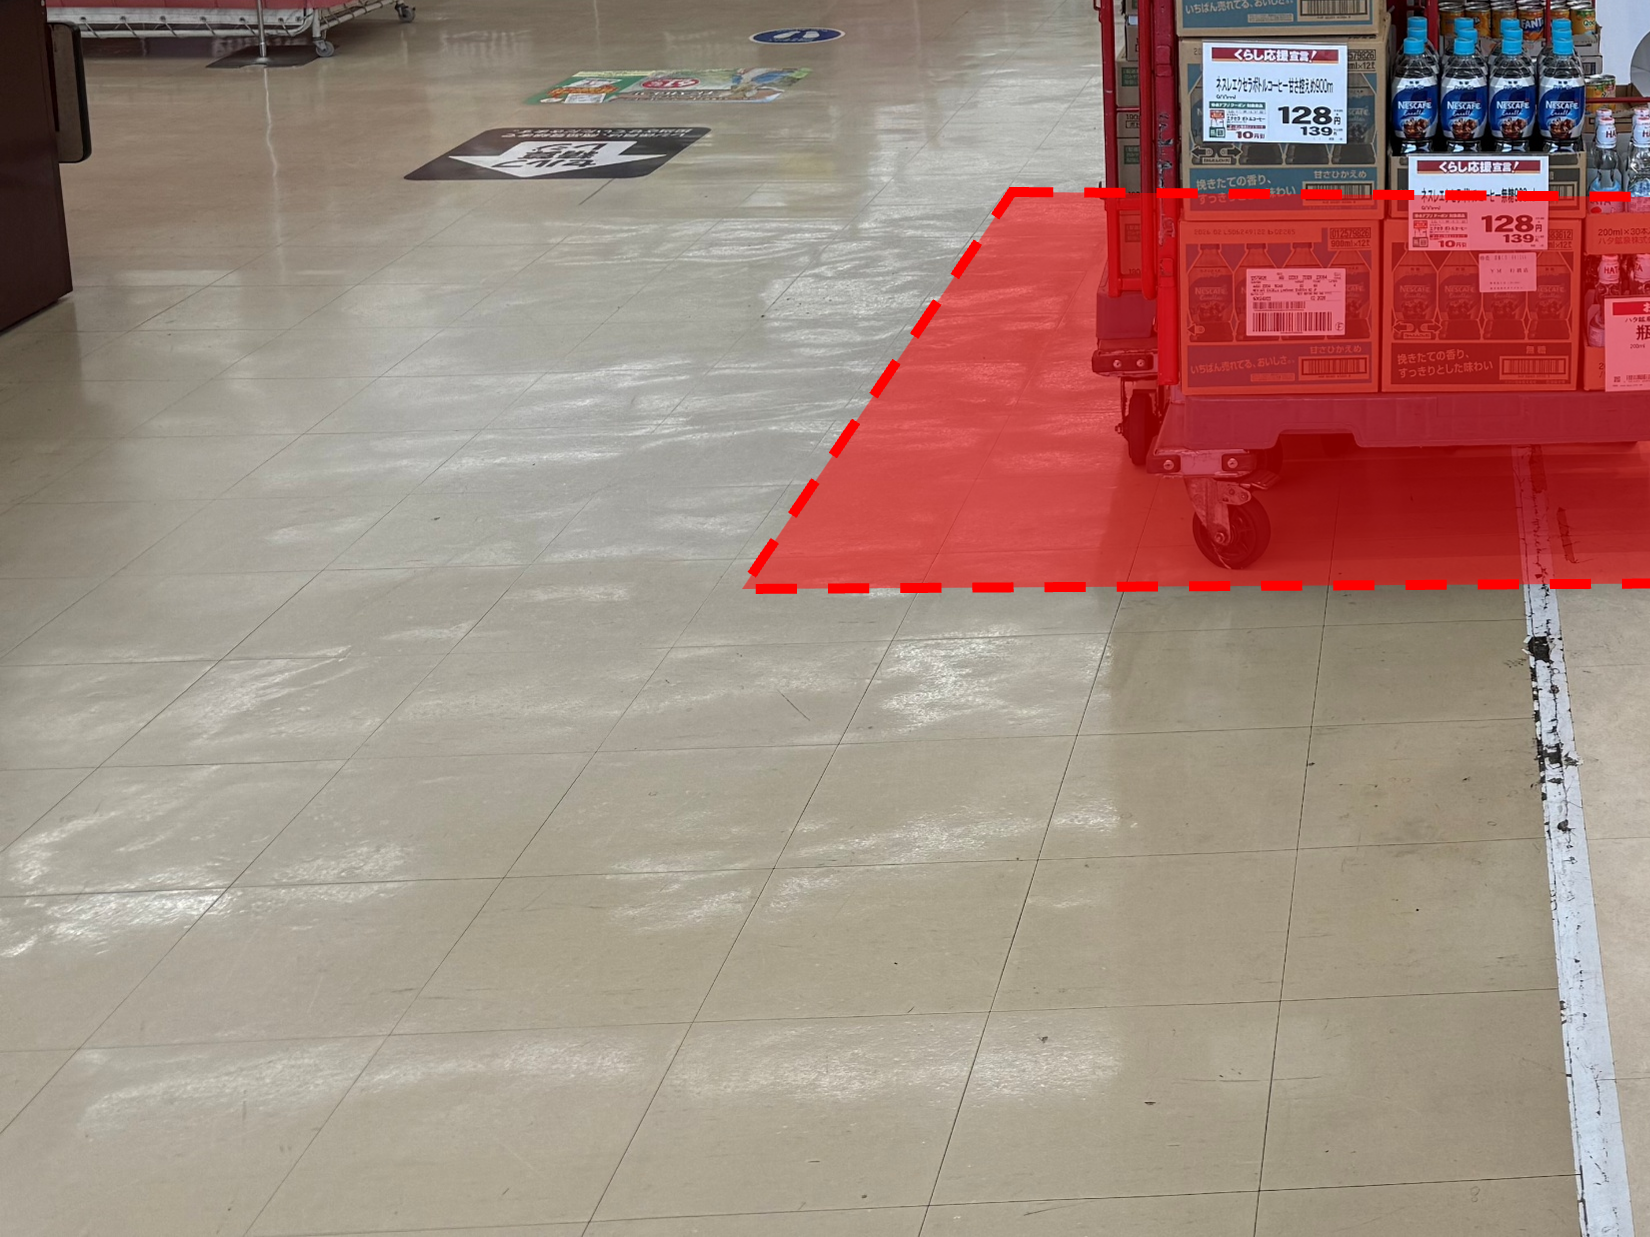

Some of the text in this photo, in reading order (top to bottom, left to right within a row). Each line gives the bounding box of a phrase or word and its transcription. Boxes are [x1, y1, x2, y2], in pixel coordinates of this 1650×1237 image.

[1234, 48, 1318, 63] くらし応援宣言!
[1277, 106, 1332, 125] 128
[1299, 126, 1333, 136] 139
[1438, 160, 1520, 174] くらし応援宣言!
[1313, 170, 1367, 179] 甘さひかえめ
[1481, 214, 1534, 233] 128
[1502, 233, 1534, 244] 139
[1309, 345, 1362, 354] 甘さひかえめ
[1398, 361, 1494, 379] すっきりとした味わい
